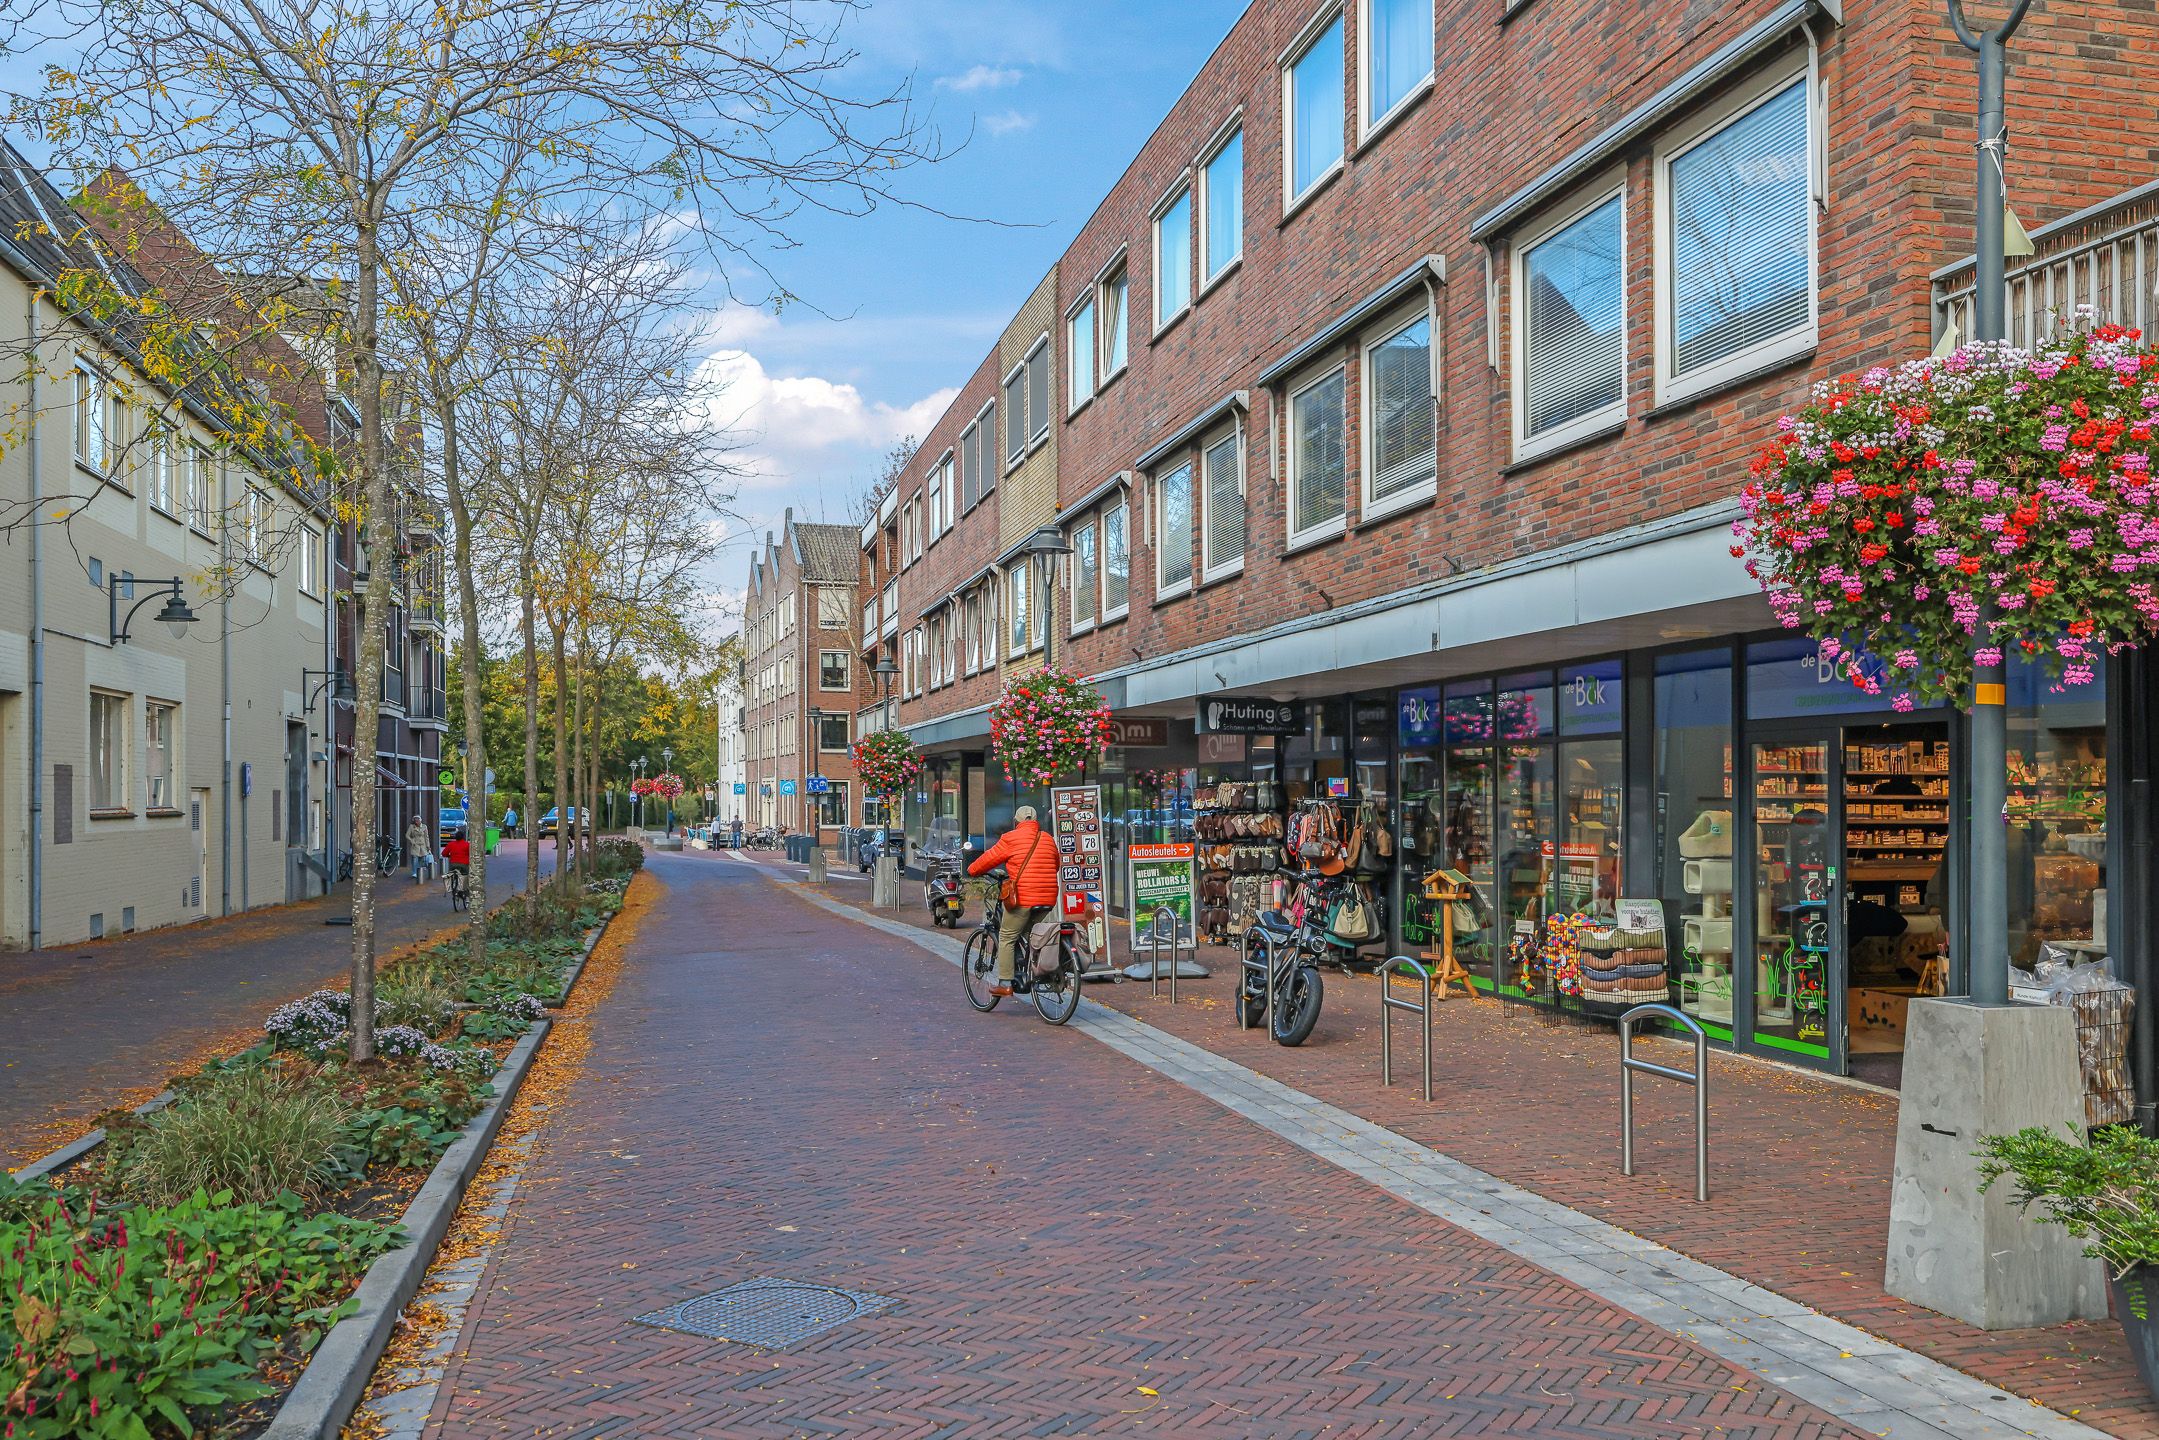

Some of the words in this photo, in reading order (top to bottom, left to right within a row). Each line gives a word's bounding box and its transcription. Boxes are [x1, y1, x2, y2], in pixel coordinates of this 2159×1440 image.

[1800, 654, 1816, 668] de
[1566, 683, 1575, 695] de
[1225, 703, 1275, 724] Huting
[1403, 704, 1410, 713] de
[1131, 844, 1178, 857] Autosleutels
[1064, 867, 1079, 880] 123
[1136, 868, 1160, 878] NIEUW!
[1137, 876, 1180, 889] ROLLATORS
[1180, 874, 1187, 884] &
